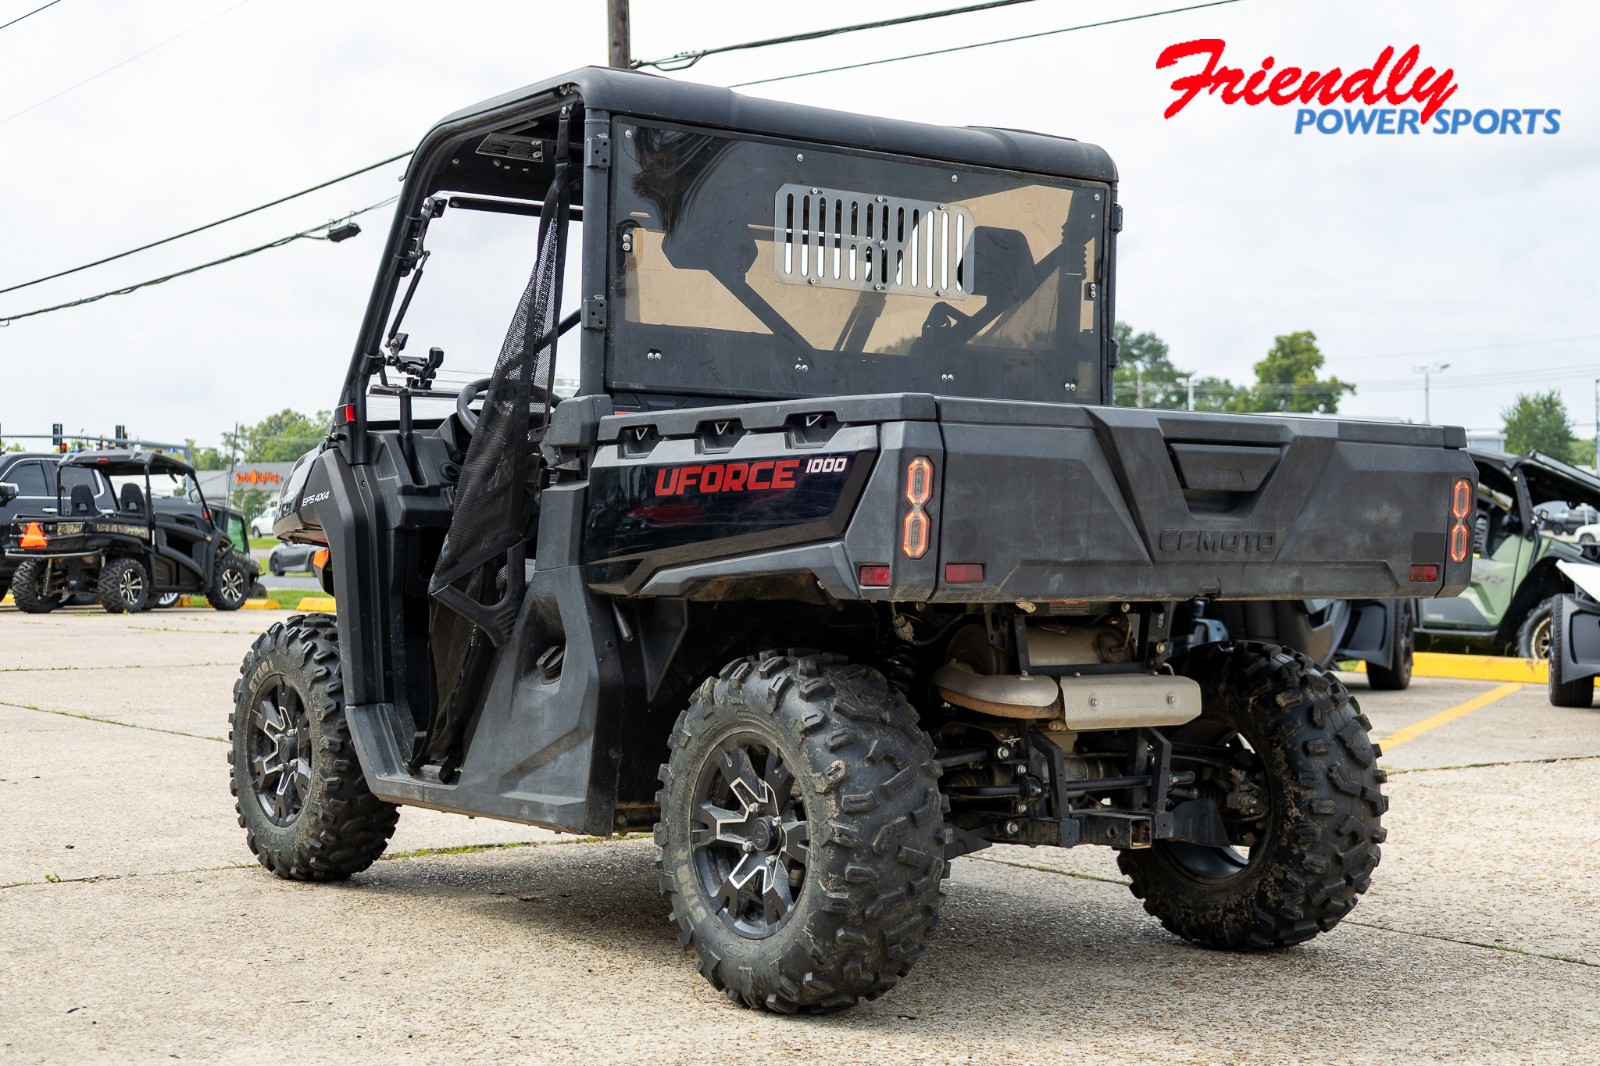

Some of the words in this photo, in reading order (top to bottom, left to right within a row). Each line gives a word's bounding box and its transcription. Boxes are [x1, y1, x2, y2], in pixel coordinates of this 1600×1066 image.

[654, 459, 800, 496] UFORCE
[805, 457, 848, 474] 1000
[301, 494, 316, 507] EPS
[315, 490, 330, 502] 4X4
[1159, 528, 1277, 553] CFMOTO
